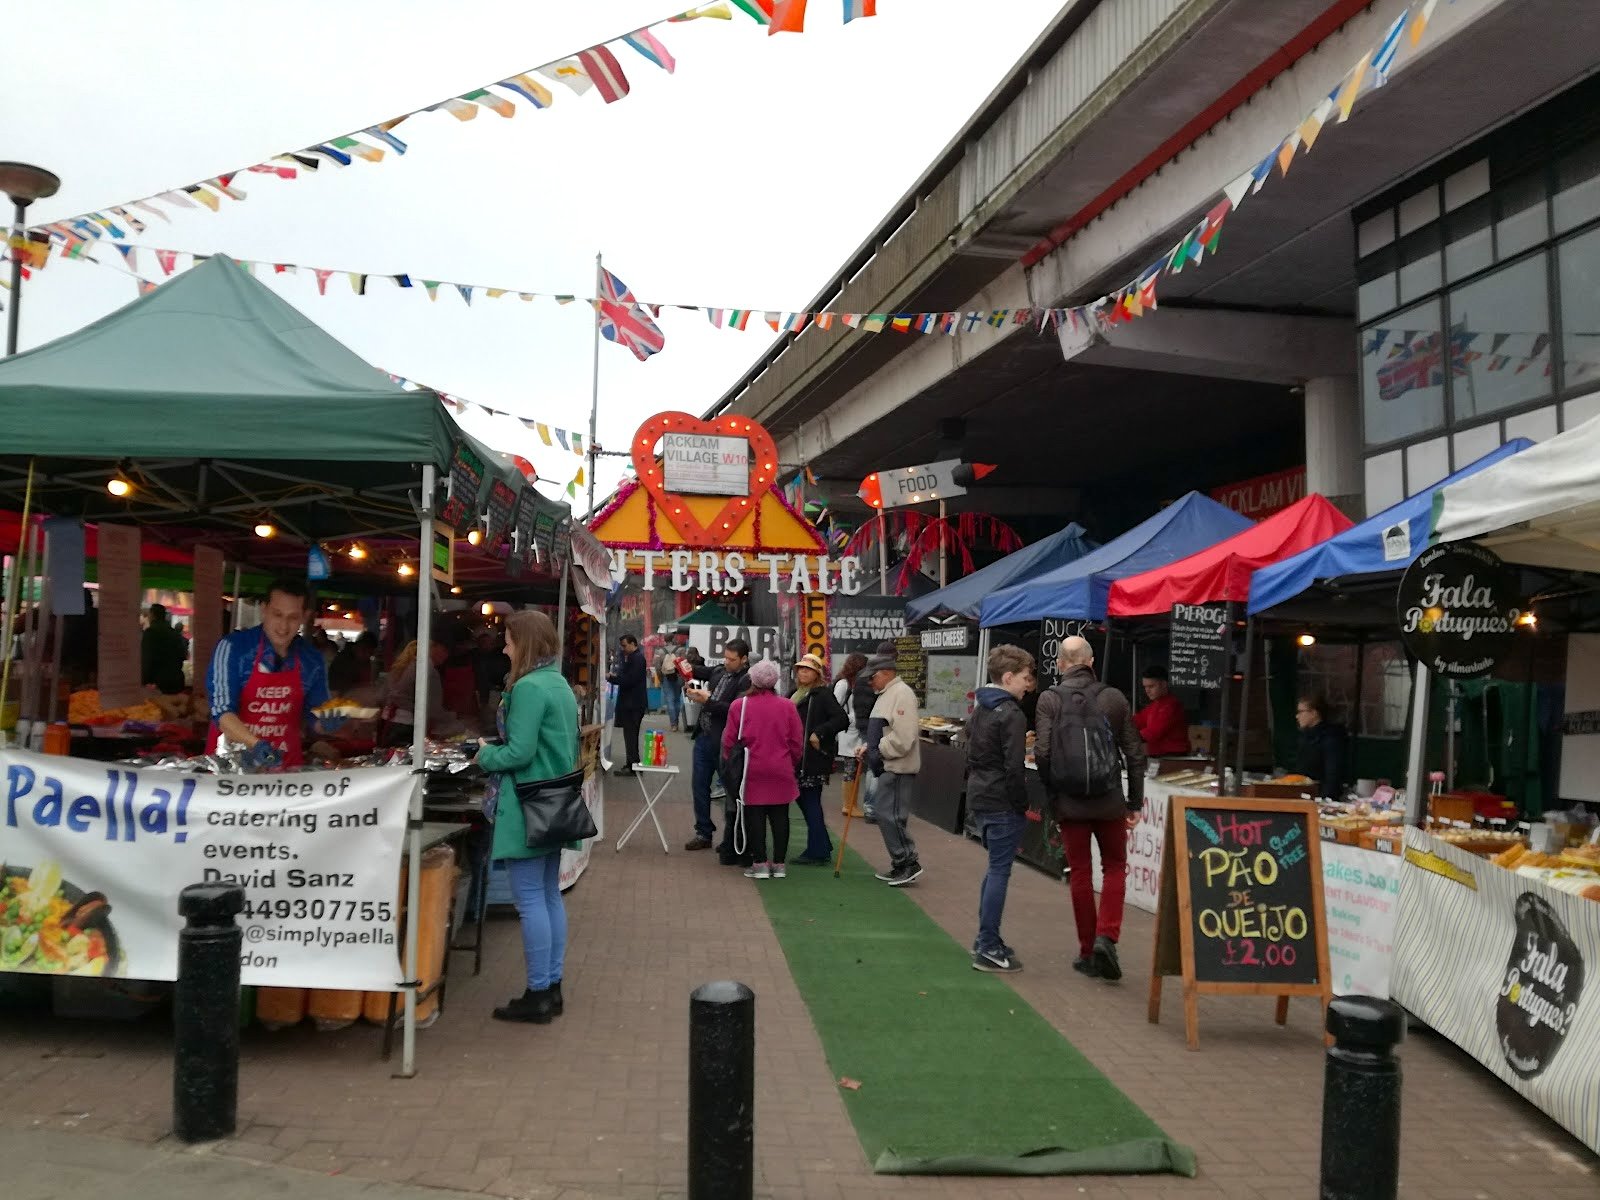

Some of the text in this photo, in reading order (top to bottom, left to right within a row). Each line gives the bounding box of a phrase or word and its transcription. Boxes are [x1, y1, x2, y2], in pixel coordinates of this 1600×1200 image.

[666, 435, 719, 449] ACKLAM
[667, 450, 748, 465] VILLAGE W10
[898, 473, 938, 495] FOOD
[758, 552, 861, 595] TALE
[1421, 573, 1495, 609] Fala
[807, 596, 826, 659] FOO
[829, 616, 905, 628] DESTINATI
[709, 626, 778, 660] BAR
[921, 629, 964, 648] GRILLED CHEESE
[255, 686, 292, 698] KEEP
[247, 701, 292, 714] CALM
[217, 776, 351, 797] Service of
[6, 764, 197, 843] Paella!
[206, 807, 379, 834] catering and
[1216, 813, 1273, 846] HOT
[203, 842, 299, 860] events.
[204, 867, 354, 889] David Sanz
[1198, 846, 1278, 888] PÃO
[1227, 889, 1254, 907] DE
[240, 951, 278, 968] don
[1520, 931, 1569, 993] Fala
